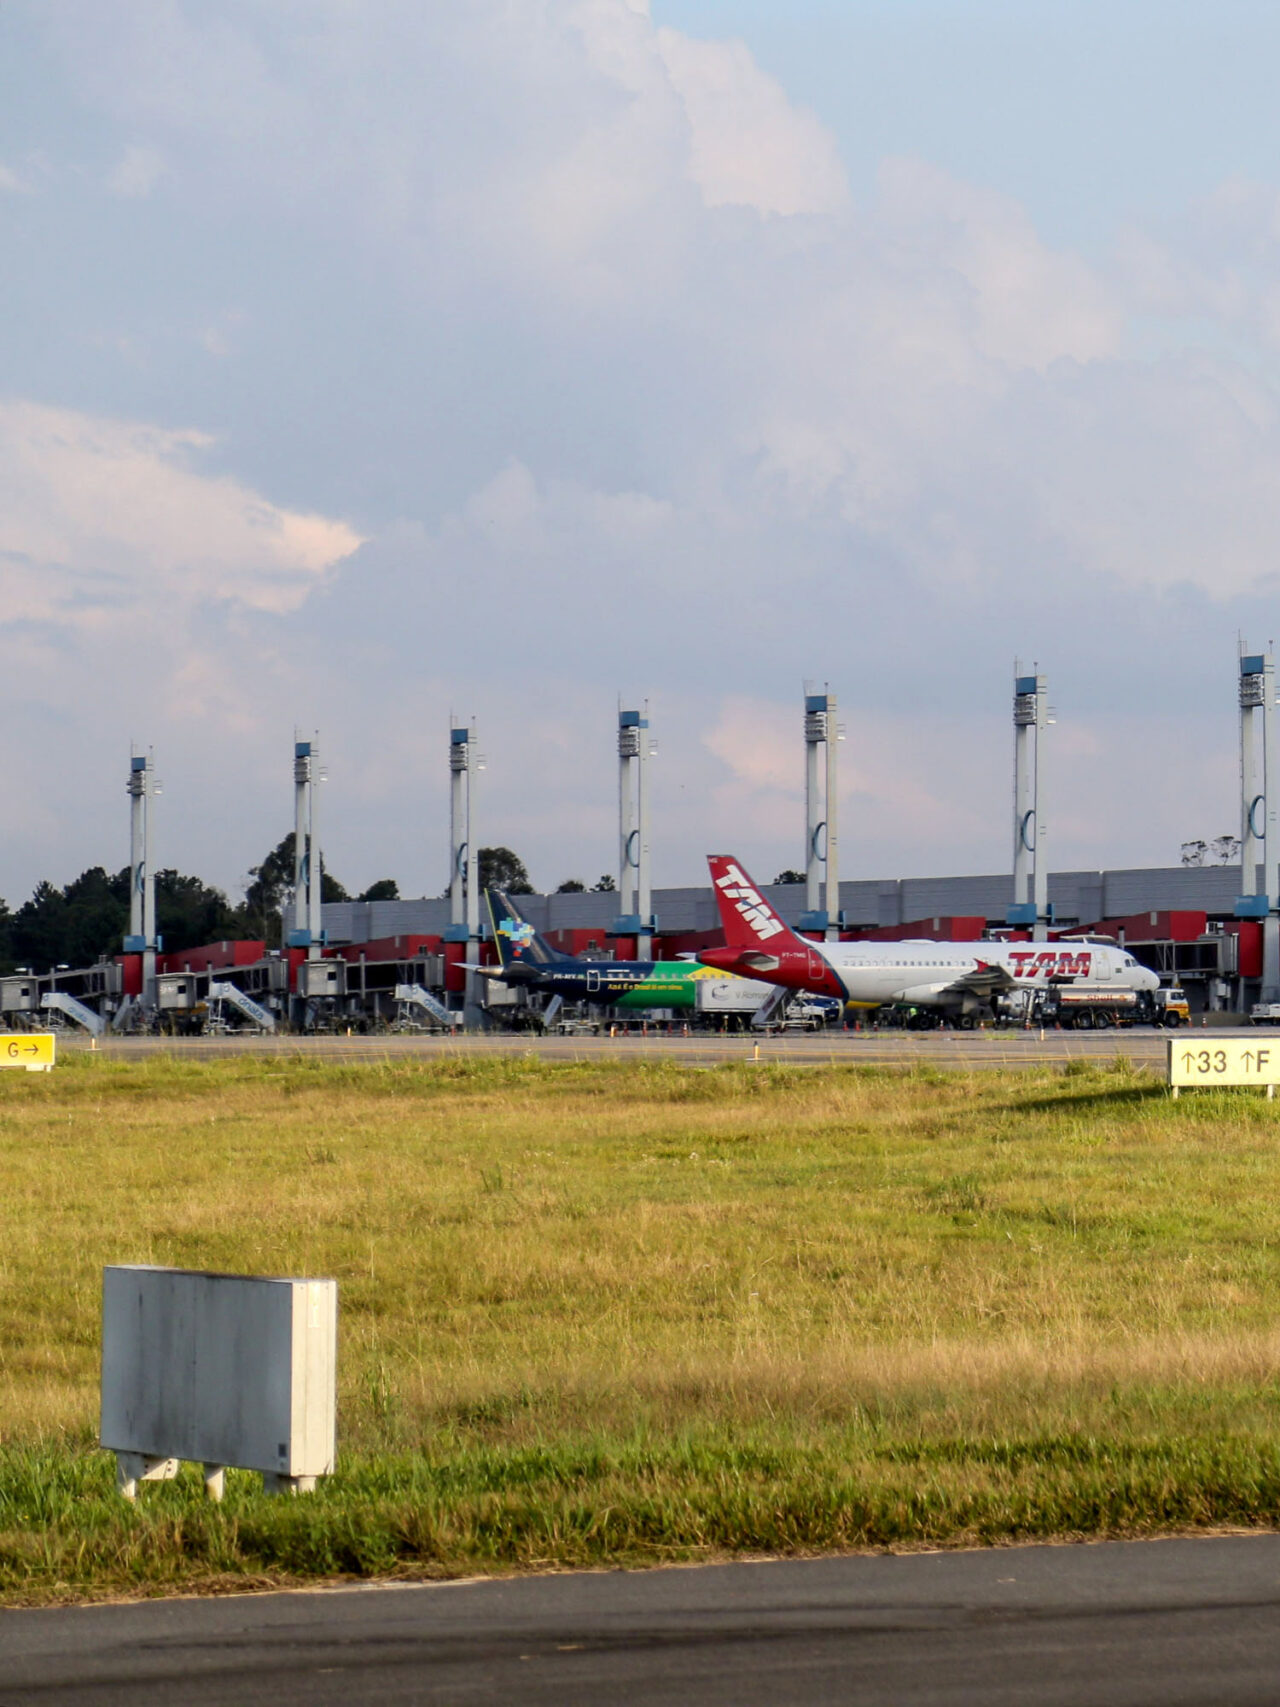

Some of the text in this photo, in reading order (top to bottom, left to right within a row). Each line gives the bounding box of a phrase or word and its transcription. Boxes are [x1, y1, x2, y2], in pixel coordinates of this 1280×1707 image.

[715, 864, 785, 941] TAM
[1008, 952, 1092, 978] TAM
[1087, 994, 1113, 1002] Shell
[8, 1042, 19, 1058] G
[1197, 1050, 1227, 1074] 33
[1256, 1050, 1271, 1073] F
